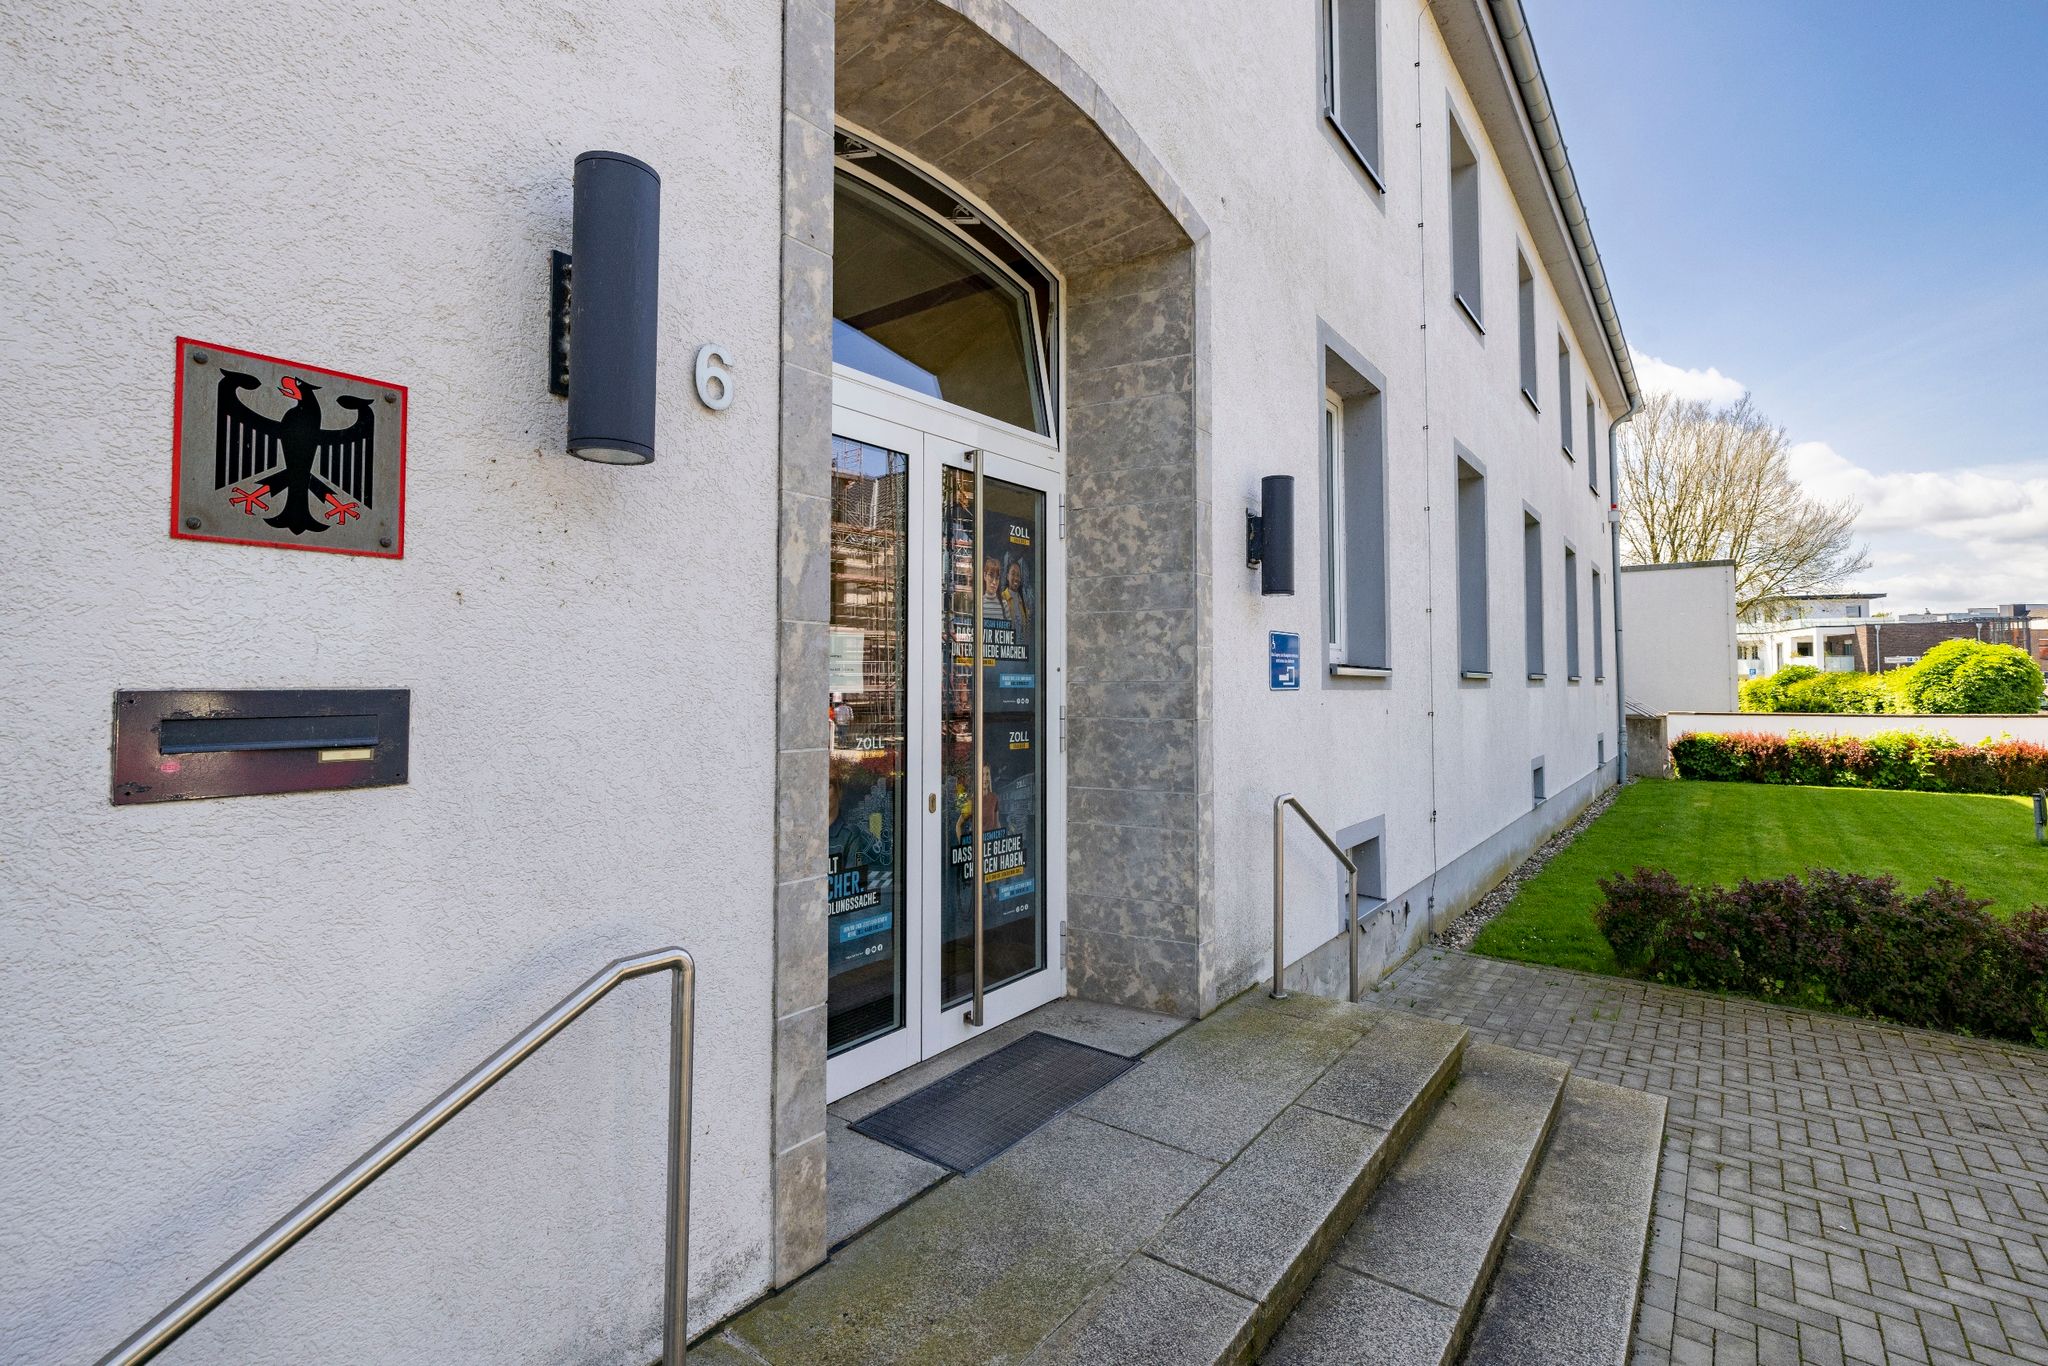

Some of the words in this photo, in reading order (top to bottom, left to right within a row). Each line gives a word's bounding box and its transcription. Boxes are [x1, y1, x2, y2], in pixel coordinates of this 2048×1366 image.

[695, 343, 735, 411] 6
[1010, 524, 1030, 539] ZOLL
[994, 630, 1015, 645] KEINE
[1001, 645, 1028, 660] MACHEN.
[855, 736, 885, 750] ZOLL
[1009, 731, 1030, 743] ZOLL
[952, 846, 973, 865] DASS
[993, 836, 1021, 856] GLEICHE
[963, 856, 998, 879] CHCEN
[999, 851, 1026, 869] HABEN.
